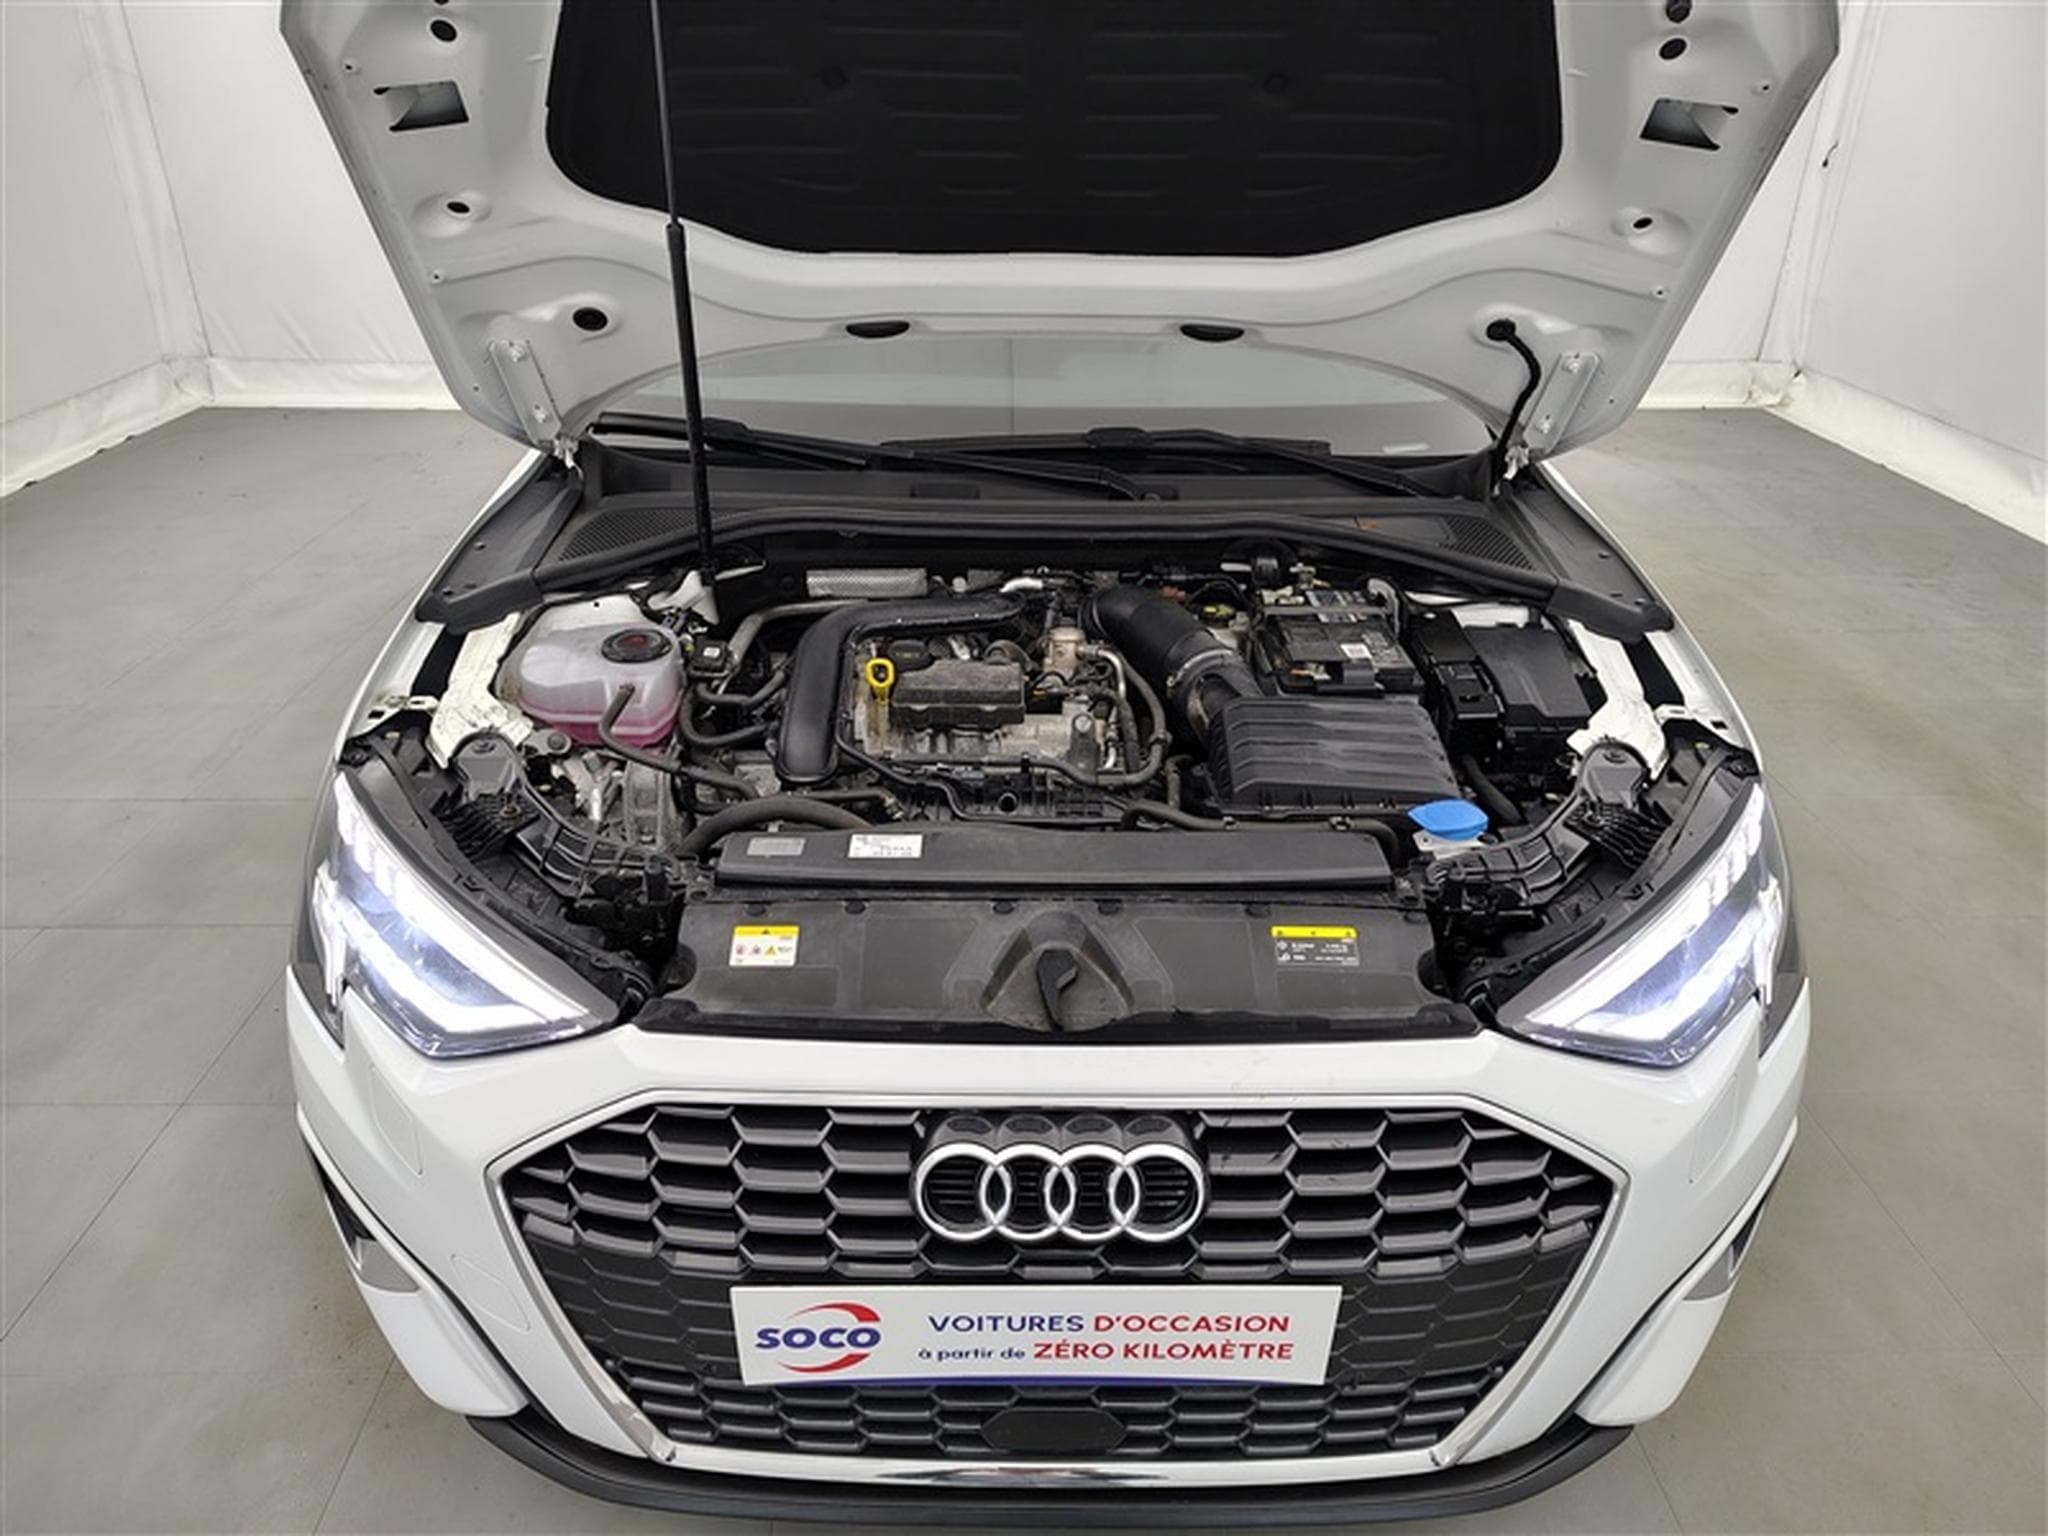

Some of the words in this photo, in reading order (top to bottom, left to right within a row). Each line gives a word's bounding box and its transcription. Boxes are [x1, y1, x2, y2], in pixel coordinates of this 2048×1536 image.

[928, 1315, 1084, 1332] VOITURES
[1094, 1315, 1290, 1332] D'OCCASION
[755, 1327, 882, 1349] SOCO
[918, 1347, 931, 1359] à
[937, 1348, 993, 1361] partir
[1000, 1348, 1025, 1359] de
[1034, 1339, 1114, 1359] ZÉRO
[1123, 1339, 1294, 1359] KILOMÈTRE
